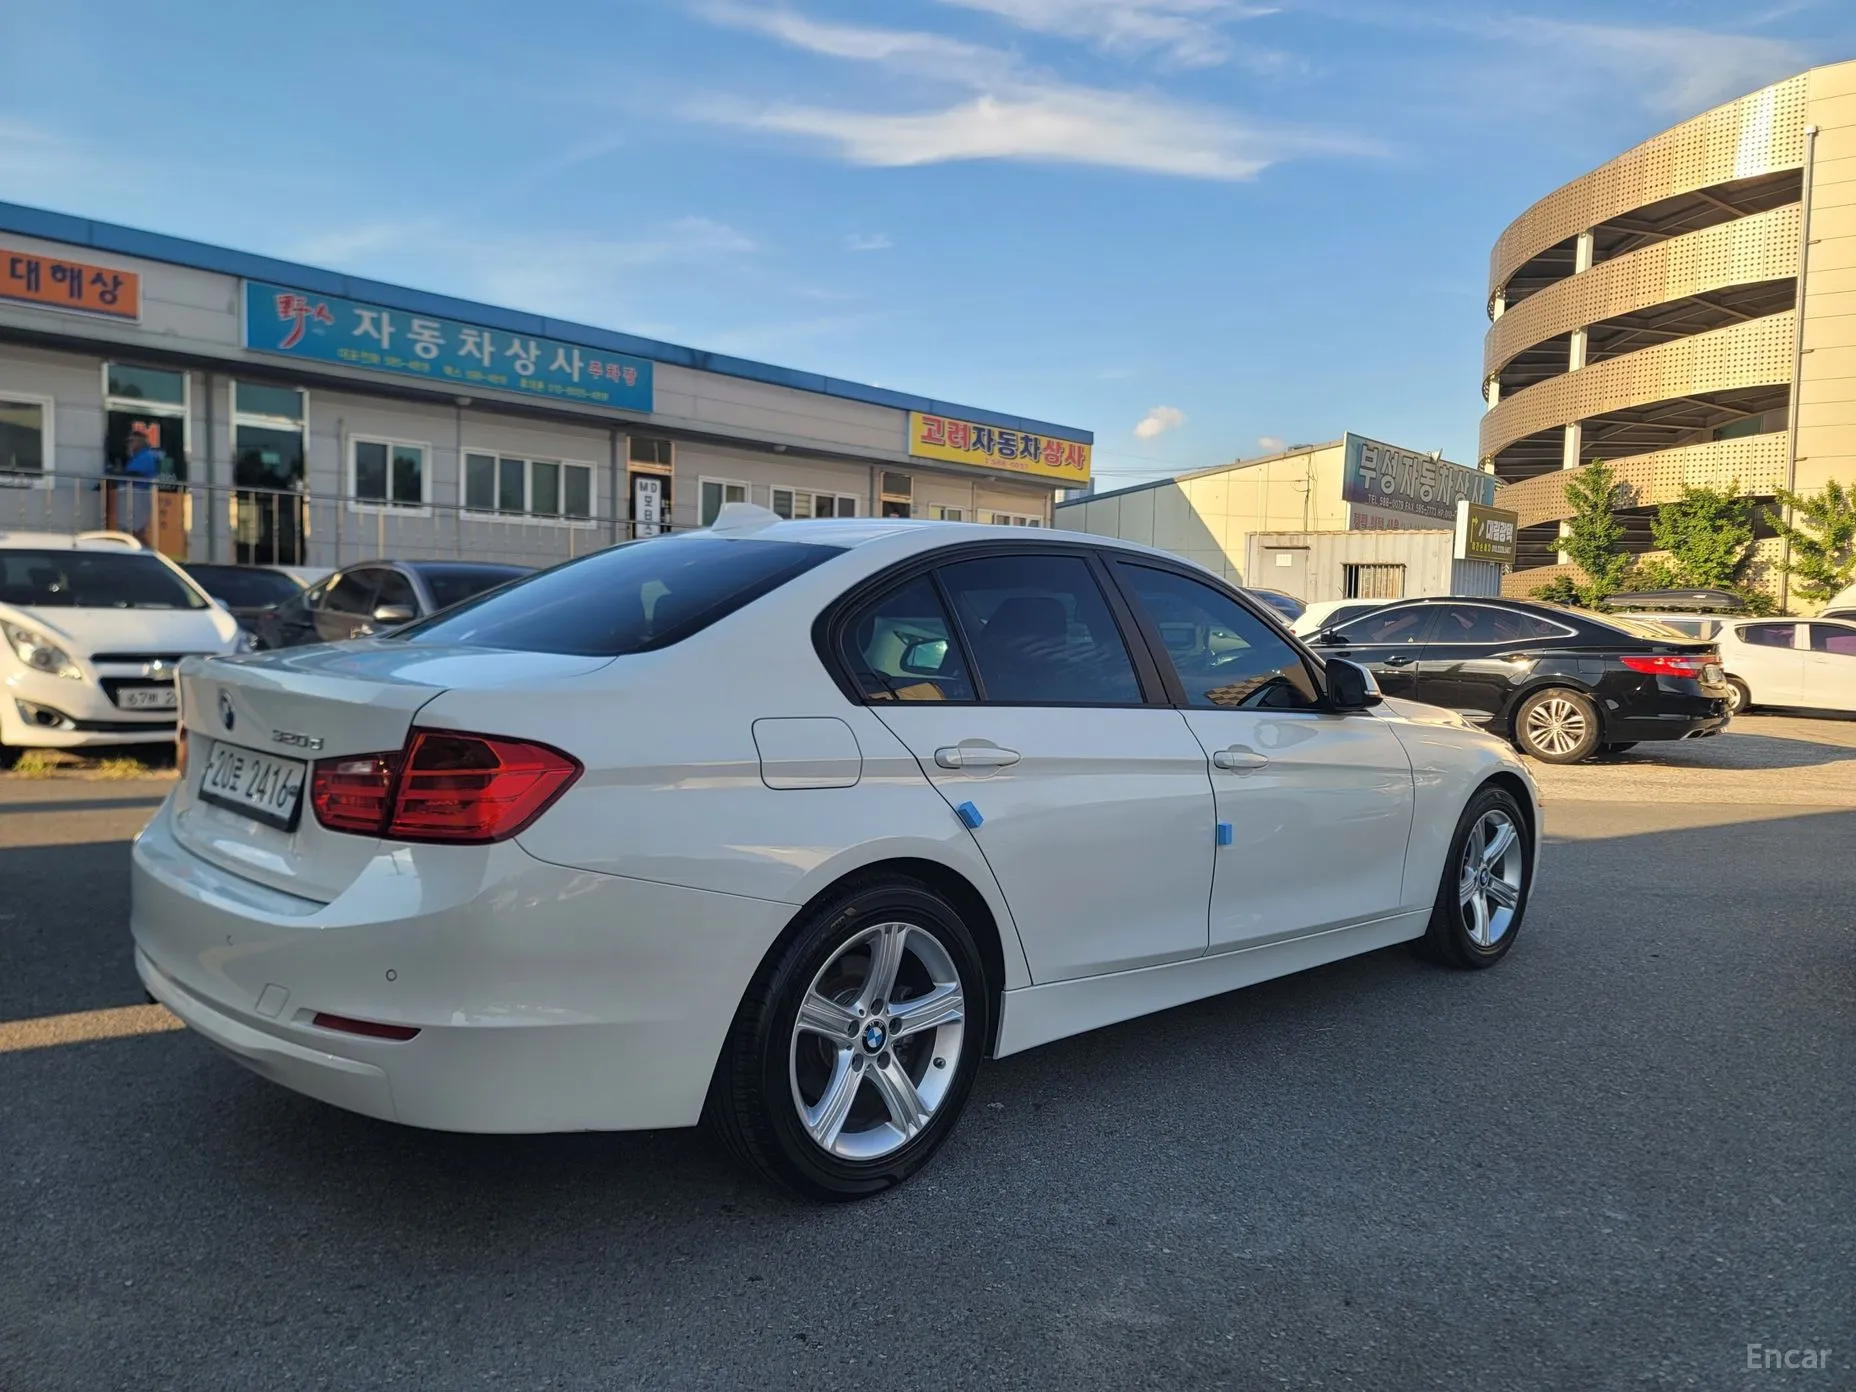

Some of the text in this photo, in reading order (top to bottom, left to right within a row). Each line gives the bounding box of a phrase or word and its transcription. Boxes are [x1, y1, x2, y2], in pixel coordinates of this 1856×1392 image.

[9, 257, 124, 305] 대해상
[352, 308, 584, 383] 자동차상사
[921, 416, 1086, 470] 고려자동차상사
[639, 481, 658, 493] MD
[1359, 443, 1485, 505] 부성자동차상사
[271, 729, 324, 750] 320d
[245, 759, 294, 809] 2416
